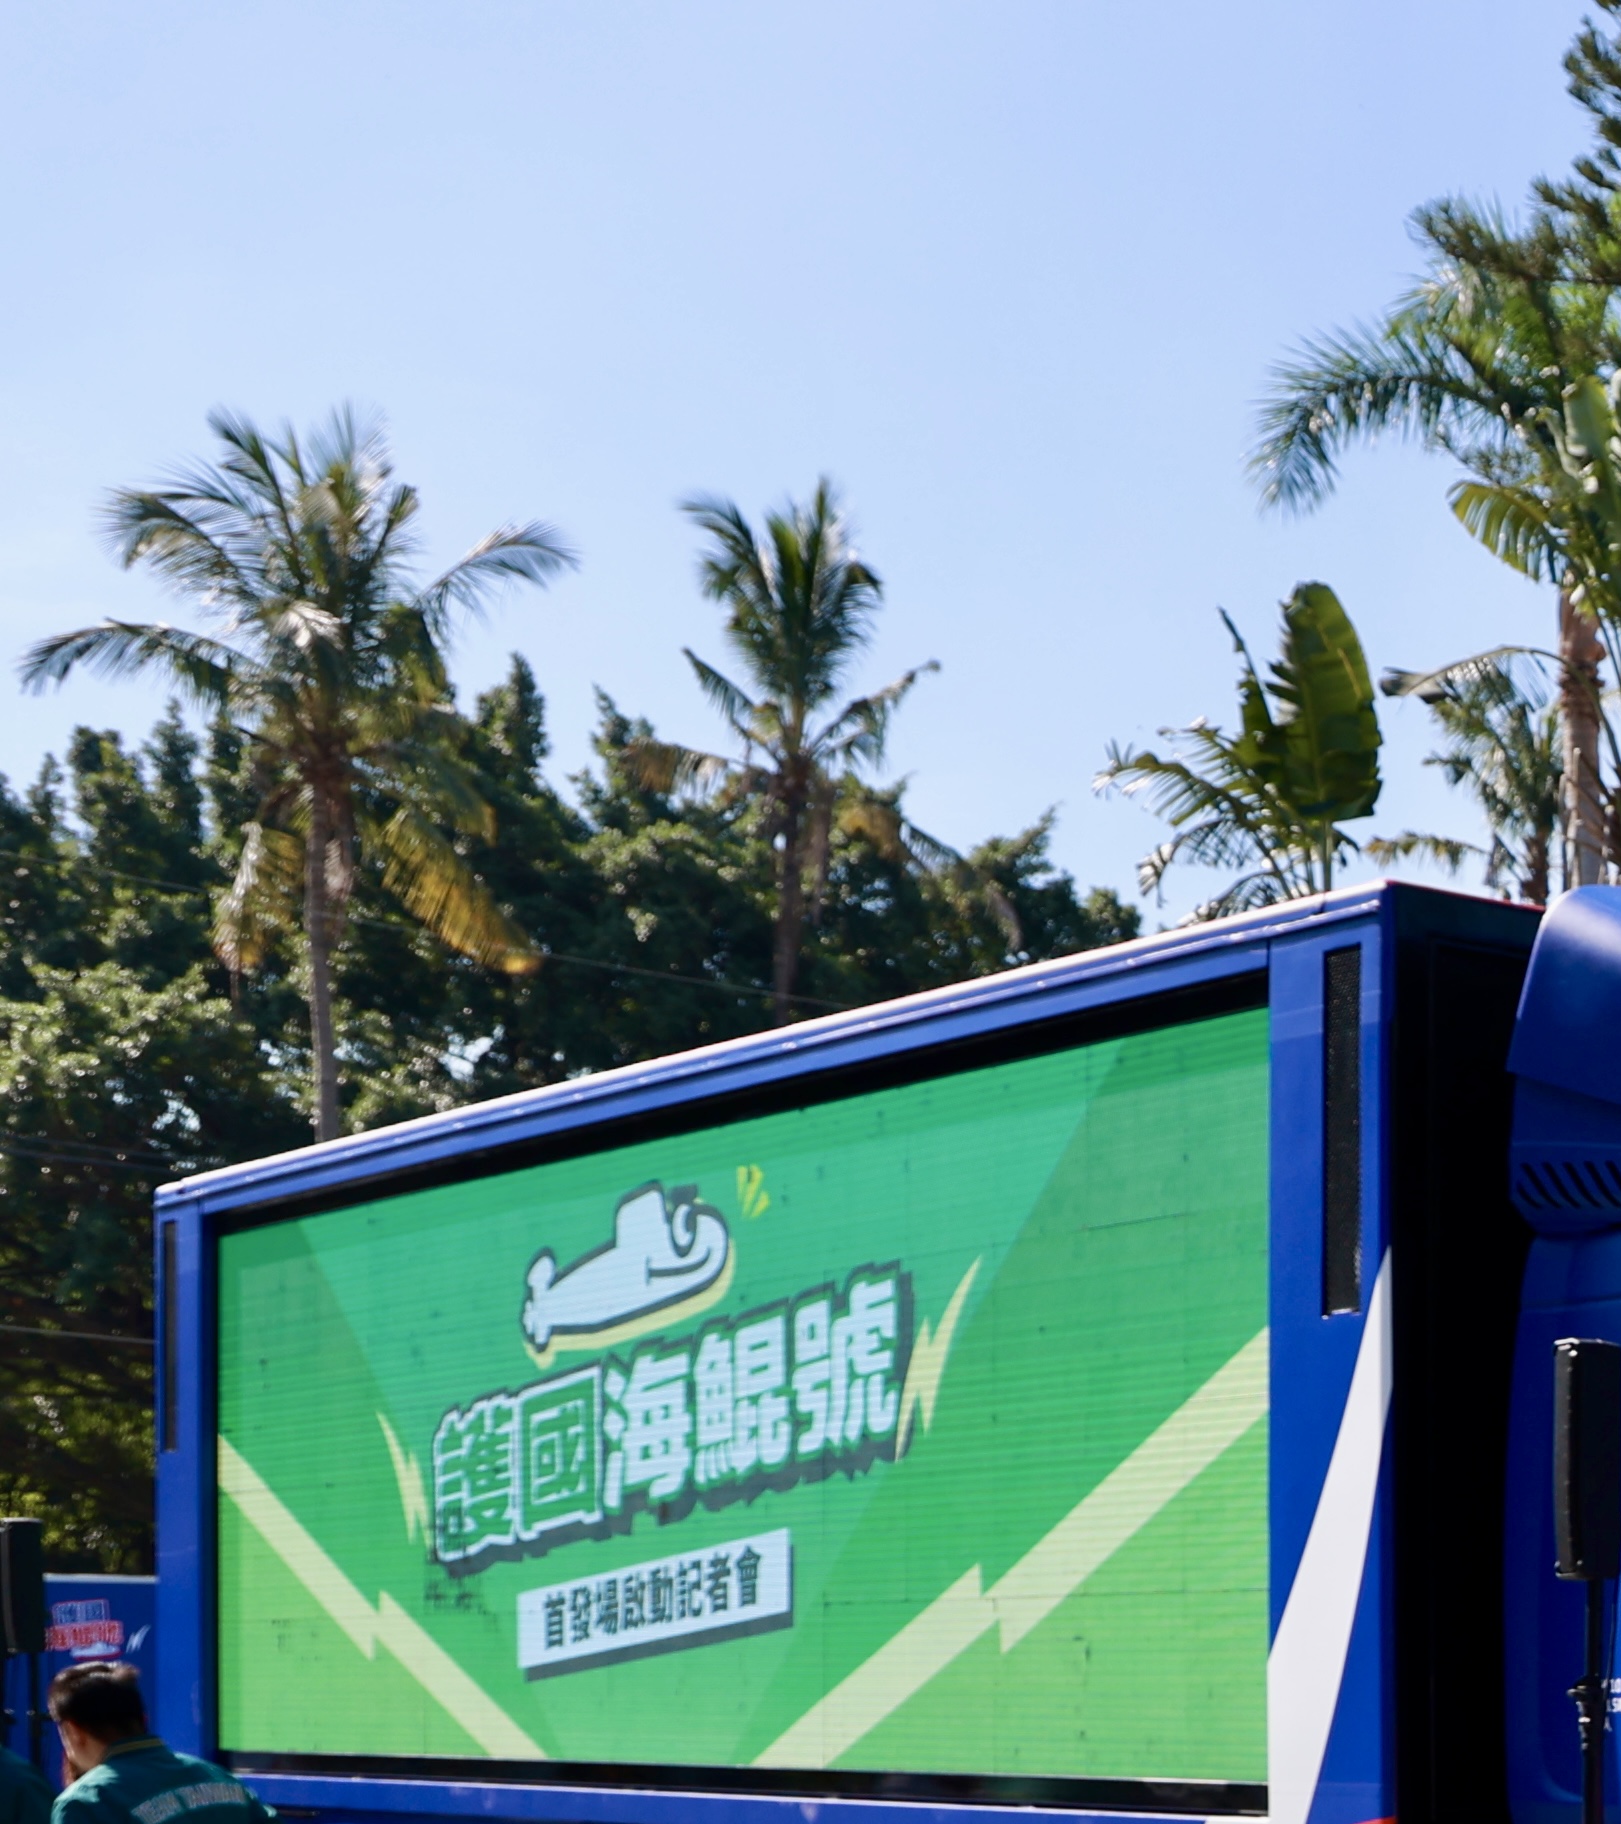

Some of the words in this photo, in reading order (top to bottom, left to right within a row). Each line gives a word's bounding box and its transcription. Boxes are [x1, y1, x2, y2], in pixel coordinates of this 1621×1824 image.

[433, 1272, 902, 1566] 護國海鯤號
[543, 1546, 764, 1650] 首發場啟動記者會
